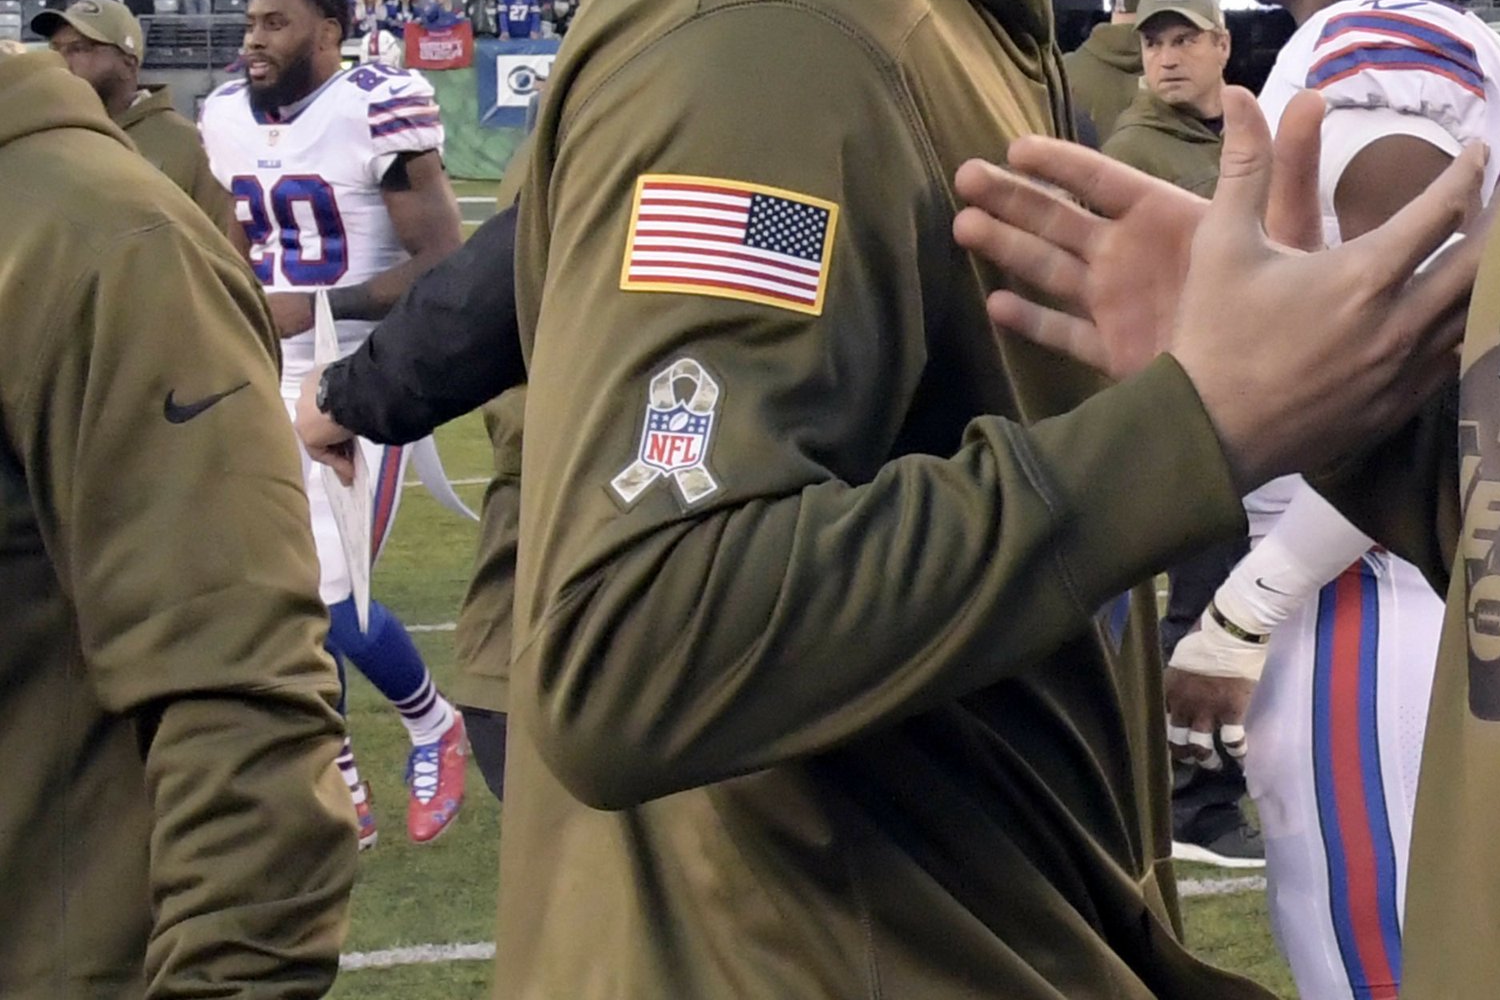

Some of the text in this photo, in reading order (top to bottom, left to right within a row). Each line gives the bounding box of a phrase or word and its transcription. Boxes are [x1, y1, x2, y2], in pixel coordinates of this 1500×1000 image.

[509, 5, 528, 21] 27
[231, 174, 349, 286] 20
[647, 433, 697, 466] NFL
